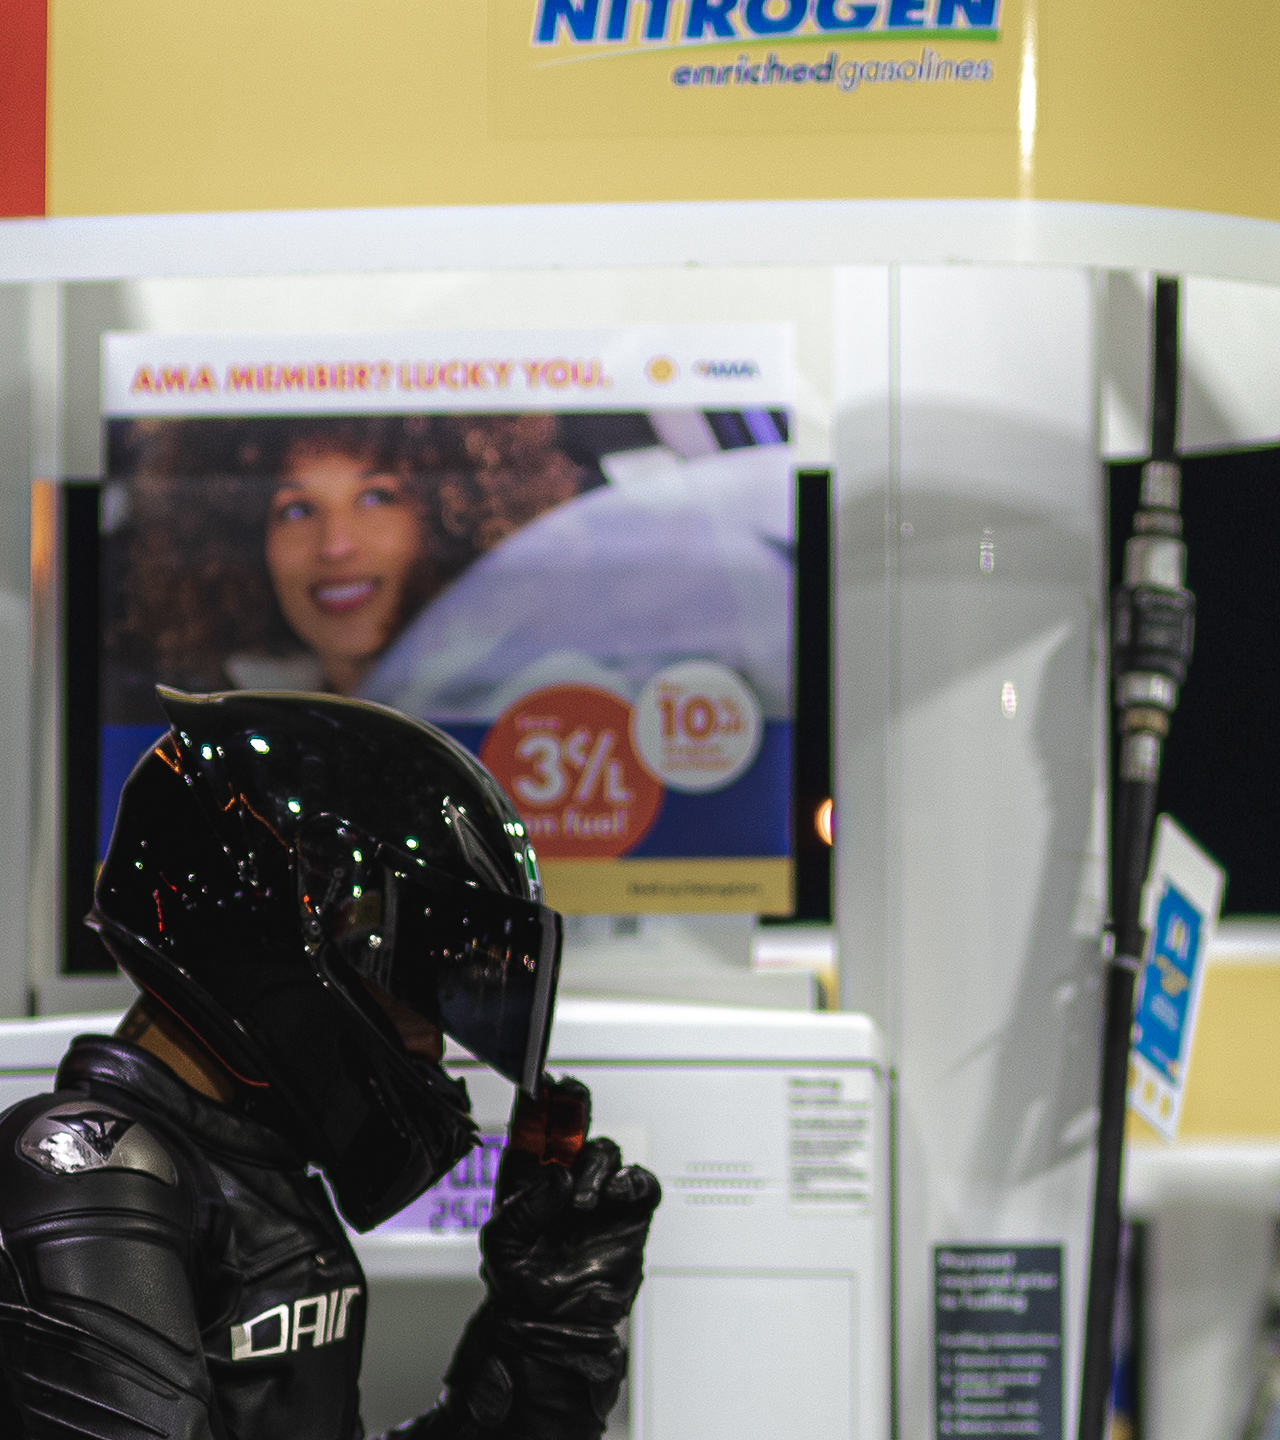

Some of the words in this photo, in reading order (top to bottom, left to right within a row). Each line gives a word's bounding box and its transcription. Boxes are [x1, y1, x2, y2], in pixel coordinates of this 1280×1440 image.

[132, 361, 219, 394] AMA
[397, 358, 515, 392] LUCKY
[521, 357, 614, 391] YOU.
